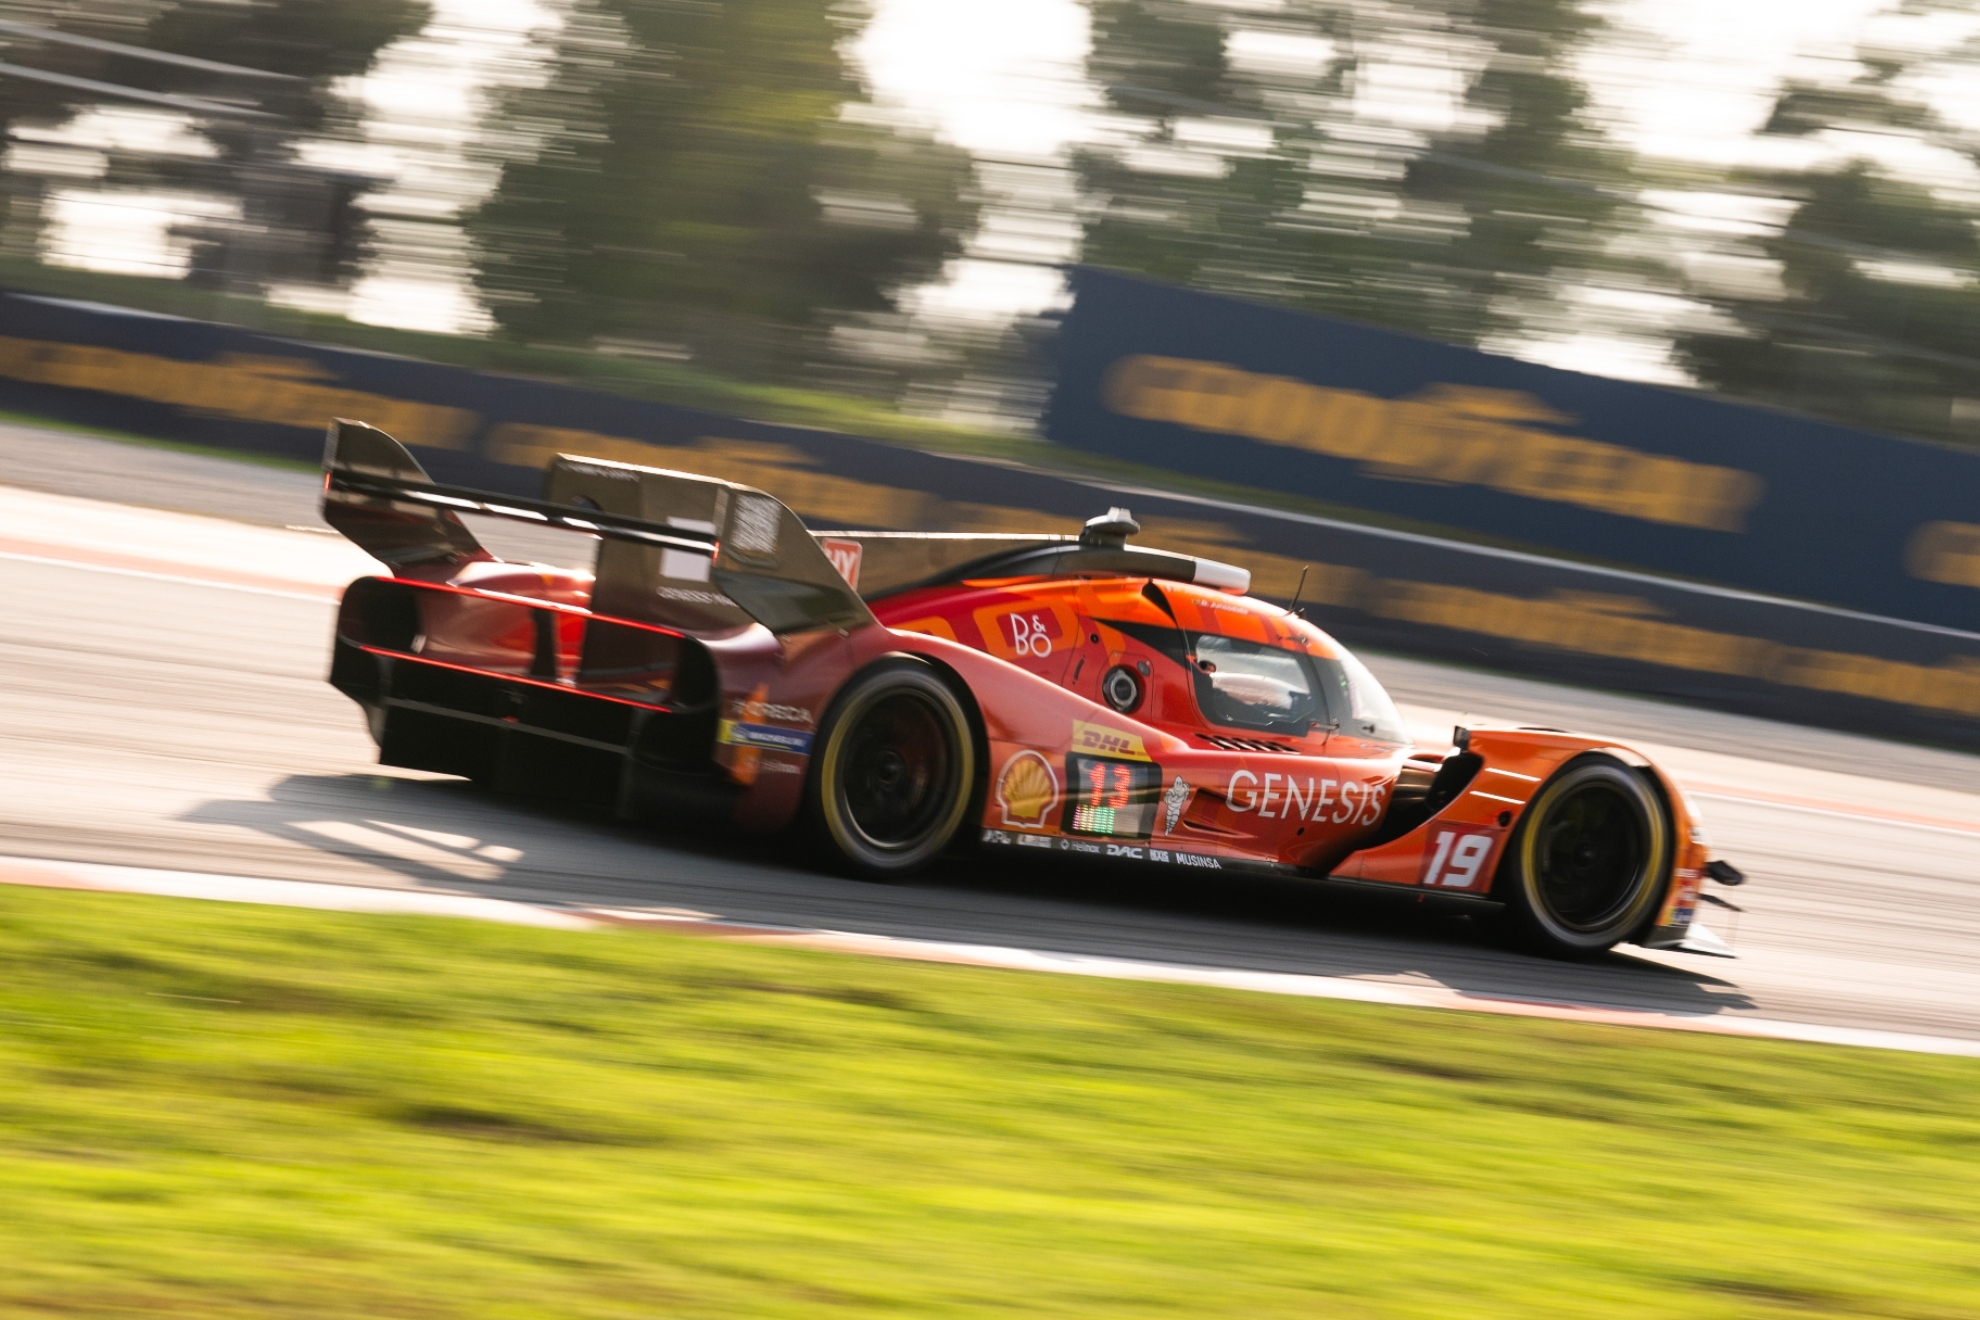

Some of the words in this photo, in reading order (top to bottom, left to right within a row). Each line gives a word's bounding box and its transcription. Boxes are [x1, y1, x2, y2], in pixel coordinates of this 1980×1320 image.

[1082, 730, 1136, 755] DHL
[1089, 762, 1131, 809] 13
[1225, 769, 1386, 826] GENESIS
[1106, 843, 1143, 859] DAC
[1175, 852, 1222, 870] MUSINSA
[1423, 831, 1493, 887] 19
